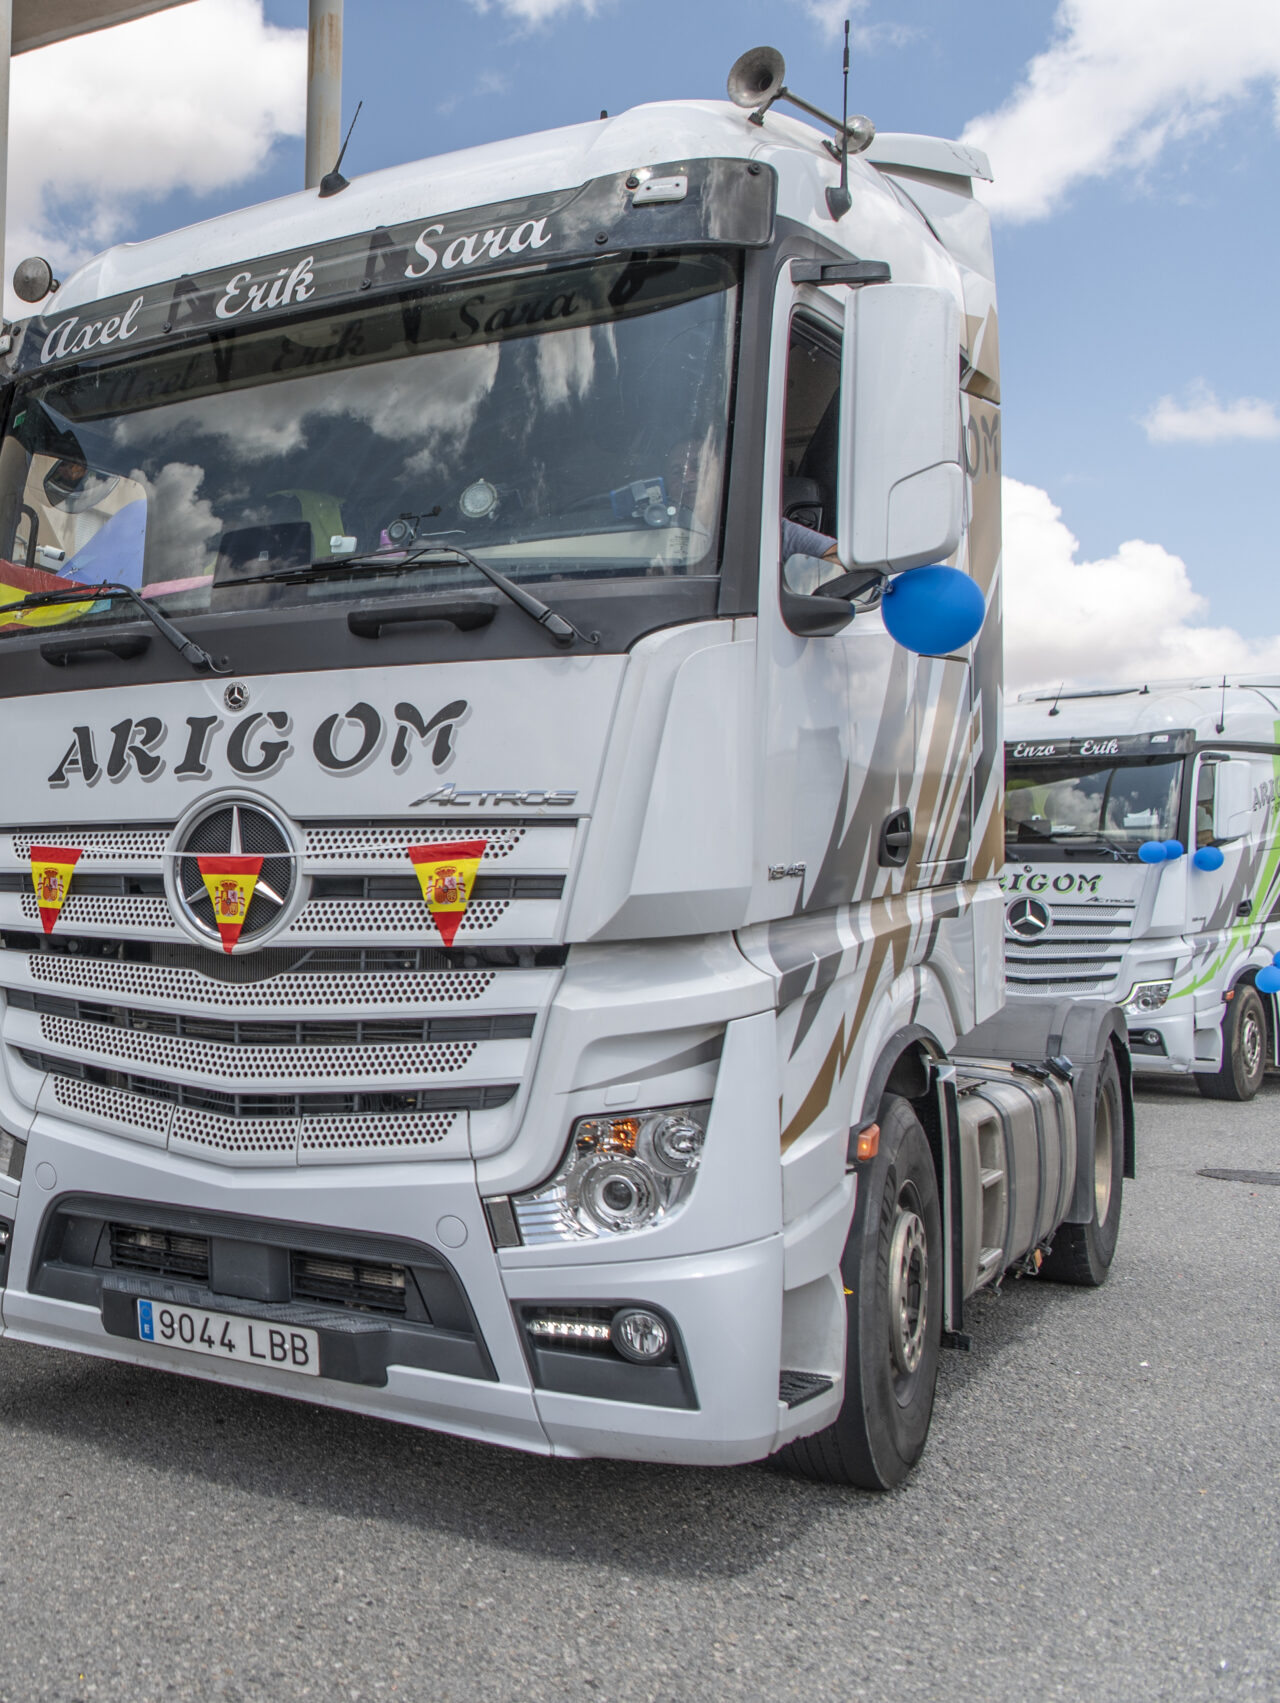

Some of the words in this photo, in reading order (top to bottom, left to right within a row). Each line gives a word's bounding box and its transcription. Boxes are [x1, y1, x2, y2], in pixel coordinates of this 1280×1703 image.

[40, 295, 144, 364] Axel
[216, 255, 316, 319] Erik
[404, 217, 552, 279] Sara
[48, 699, 470, 789] ARIGOM
[1013, 742, 1056, 758] Enzo
[1080, 738, 1119, 756] Erik
[409, 782, 579, 808] ACTROS
[159, 1309, 236, 1353] 9044
[248, 1325, 310, 1367] LBB
